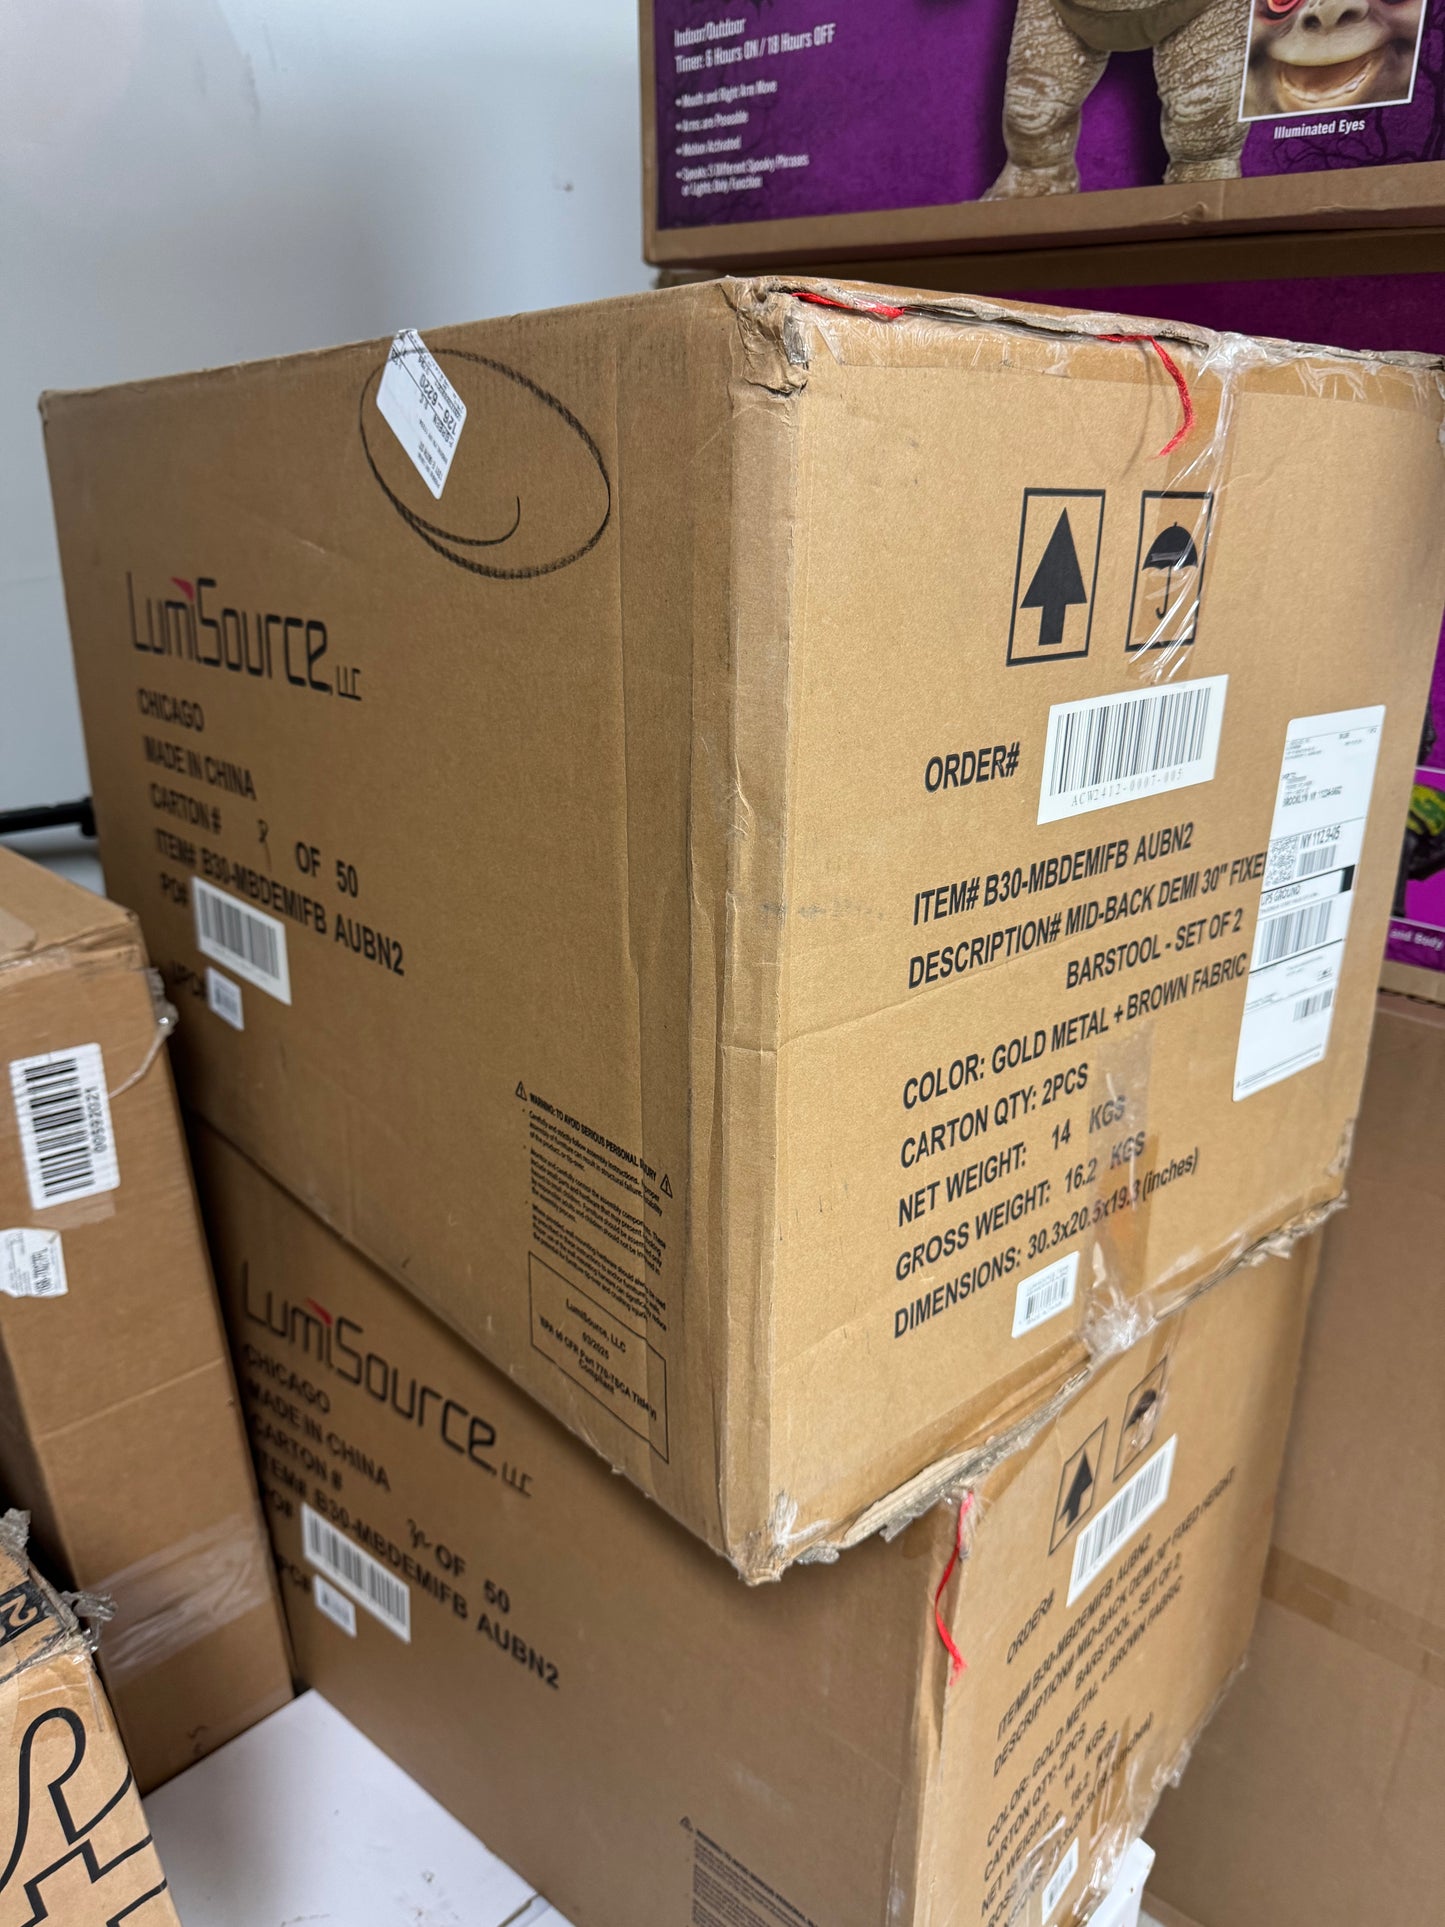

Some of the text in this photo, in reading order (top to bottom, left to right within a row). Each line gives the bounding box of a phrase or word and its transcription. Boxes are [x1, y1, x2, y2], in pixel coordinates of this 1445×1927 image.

[674, 18, 747, 48] Indoor/Outdoor
[675, 54, 705, 74] Timer:
[714, 46, 743, 65] Hours
[744, 40, 759, 60] ON
[759, 37, 767, 57] /
[781, 31, 813, 53] Hours
[813, 23, 836, 46] OFF
[1273, 118, 1365, 140] Illuminated Eyes
[137, 687, 205, 733] CHICAGO
[143, 736, 258, 801] MADE IN CHINA
[924, 741, 1021, 794] ORDER#
[295, 841, 321, 878] OF
[335, 858, 359, 898] 50
[913, 821, 1194, 926] ITEM# B30-MBDEMIFB AUBN2
[334, 913, 405, 977] AUBN2
[908, 851, 1267, 990] DESCRIPTION# MID-BACK DEMI 30" FIXE
[1066, 935, 1161, 990] BARSTOOL
[1175, 918, 1207, 952] SET
[1209, 912, 1232, 940] OF
[1232, 907, 1243, 934] 2
[903, 1052, 985, 1110] COLOR:
[992, 1030, 1046, 1075] GOLD
[1051, 1006, 1109, 1053] METAL
[1114, 1003, 1123, 1024] +
[1126, 974, 1189, 1021] BROWN
[1191, 952, 1248, 996] FABRIC
[901, 1062, 1089, 1169] CARTON QTY: 2PCS
[899, 1094, 1126, 1228] NET WEIGHT: 14 KGS
[895, 1222, 970, 1282] GROSS
[975, 1179, 1051, 1241] WEIGHT:
[1065, 1157, 1097, 1194] 16.2
[894, 1245, 1021, 1340] DIMENSIONS:
[242, 1342, 331, 1415] CHICAGO
[611, 1333, 626, 1354] LLC
[304, 1414, 323, 1443] IN
[326, 1431, 391, 1493] CHINA
[434, 1543, 467, 1578] OF
[483, 1578, 511, 1614] 50
[476, 1612, 560, 1692] AUBN2
[1075, 1610, 1130, 1692] BARSTOOL
[1032, 1726, 1064, 1778] GOLD
[984, 1799, 1032, 1883] CARTON
[981, 1869, 1005, 1918] NET
